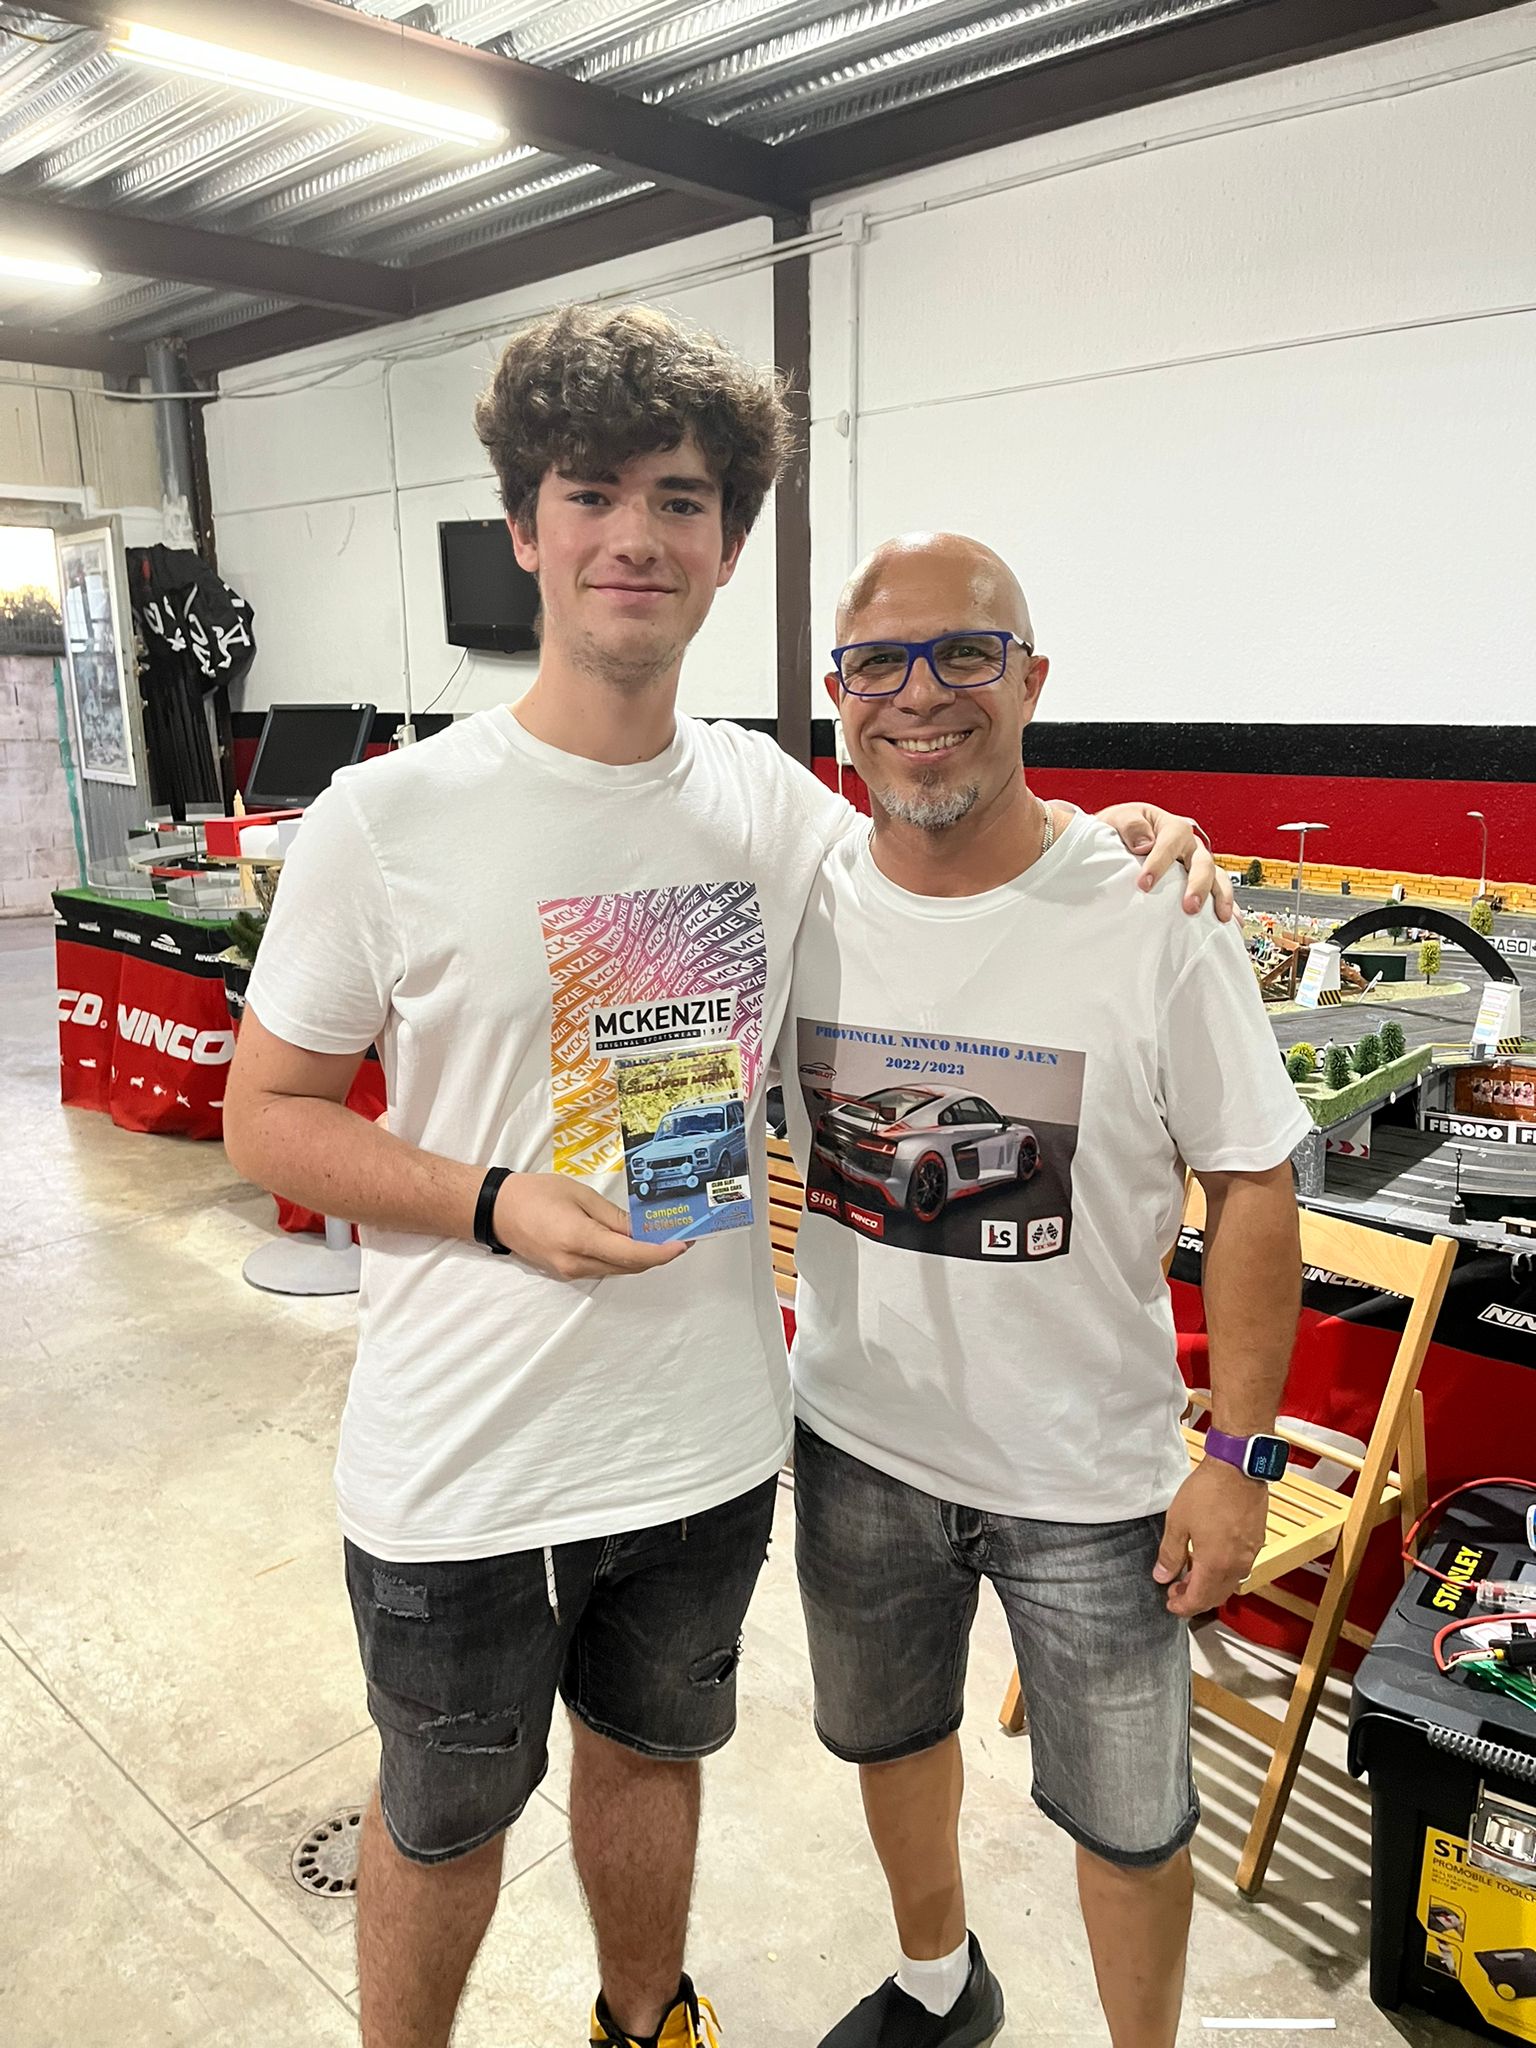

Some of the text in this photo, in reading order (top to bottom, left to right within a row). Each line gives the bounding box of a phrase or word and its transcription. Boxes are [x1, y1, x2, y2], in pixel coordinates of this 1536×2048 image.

[595, 998, 732, 1038] MCKENZIE
[597, 1039, 640, 1050] ORIGINAL
[643, 1030, 698, 1044] SPORTSWEAR
[815, 1025, 1059, 1066] PROVINCIAL NINCO MARIO JAEN
[885, 1056, 965, 1076] 2022/2023
[1429, 1119, 1504, 1140] FERODO
[810, 1191, 838, 1209] Slot
[645, 1203, 690, 1220] Campeón
[850, 1211, 879, 1229] NINCO
[1432, 1857, 1492, 1887] PROMOBILE
